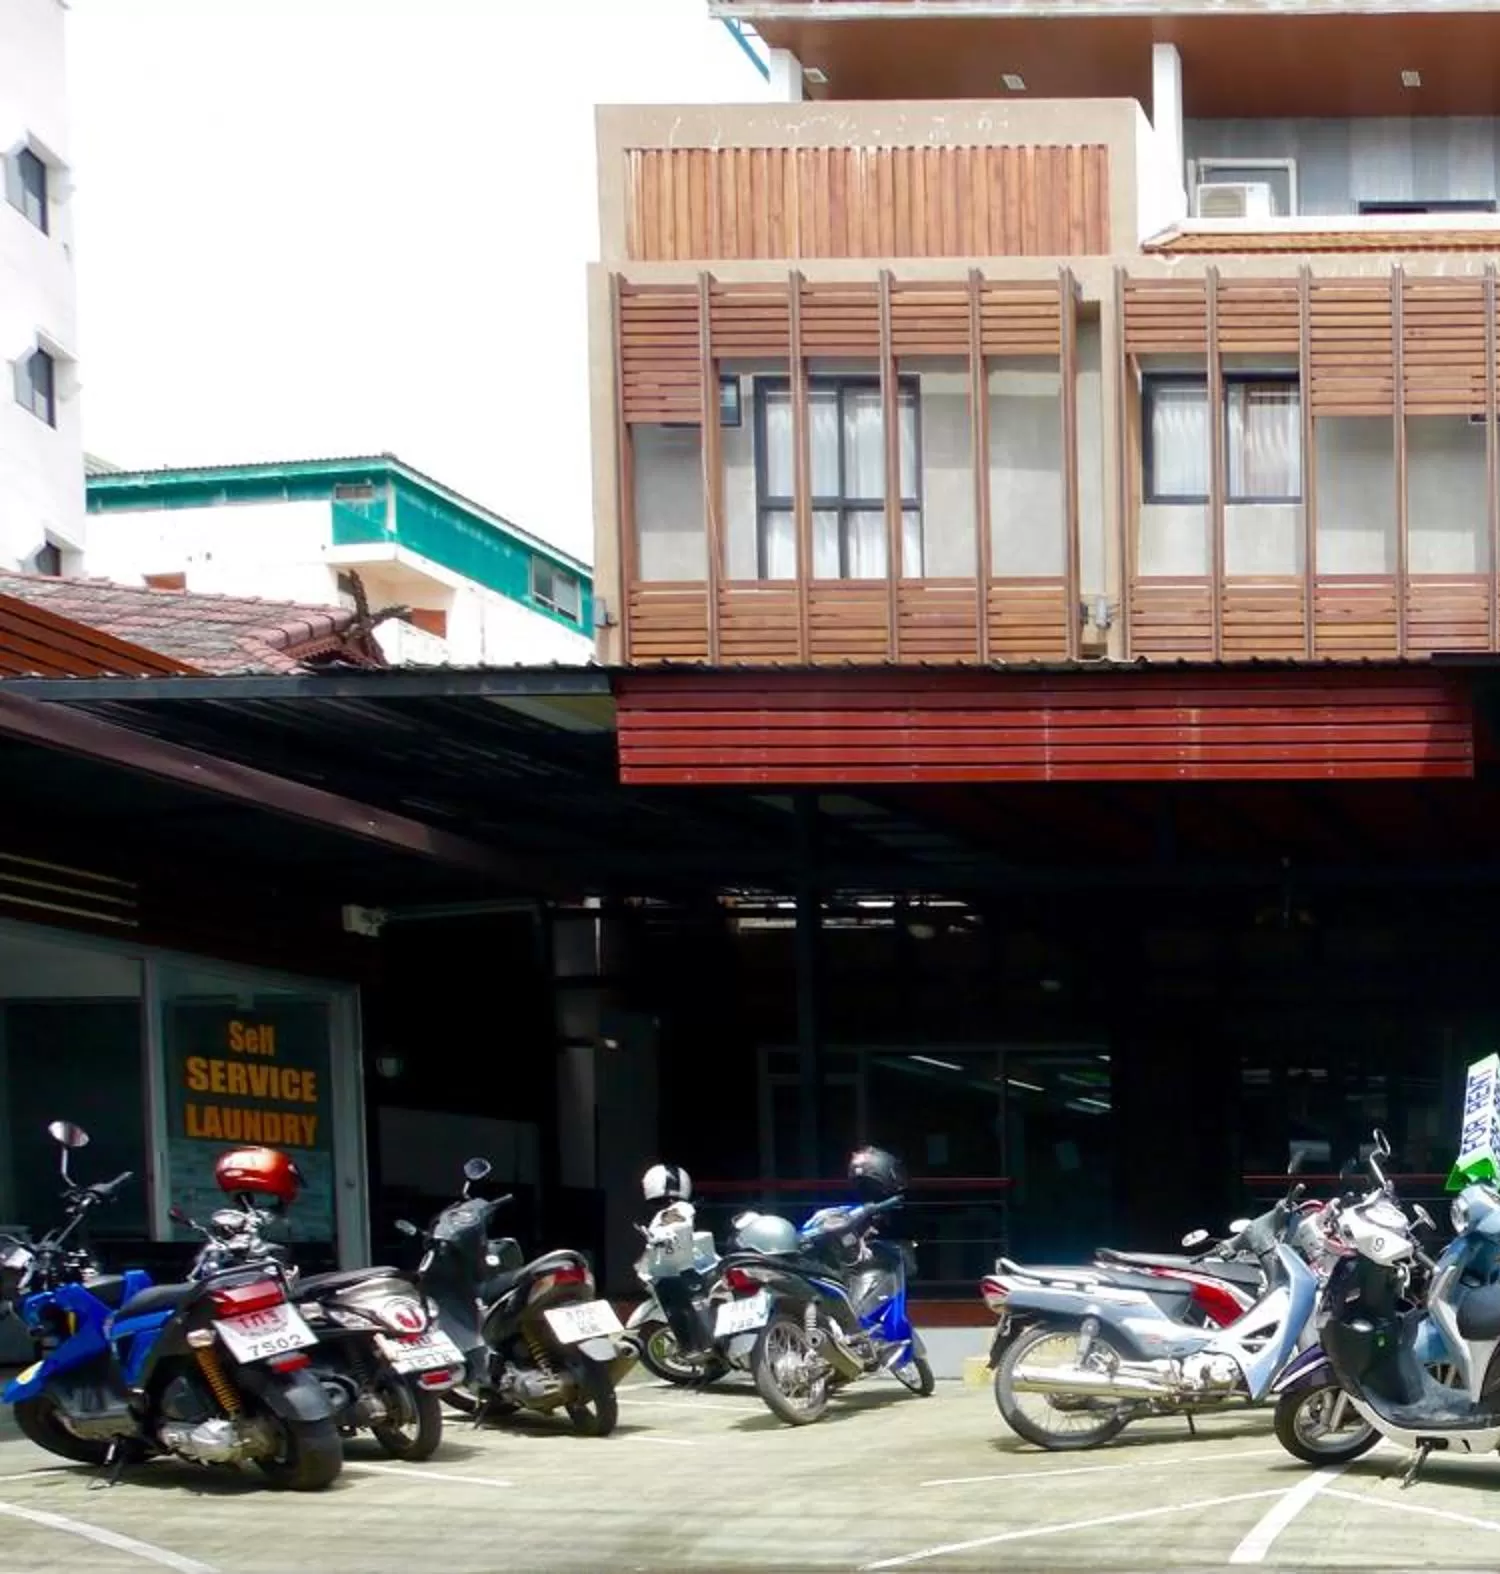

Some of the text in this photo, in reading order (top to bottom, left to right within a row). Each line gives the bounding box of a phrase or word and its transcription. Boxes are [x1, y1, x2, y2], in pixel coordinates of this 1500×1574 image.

[228, 1020, 275, 1056] Self
[185, 1056, 317, 1102] SERVICE
[185, 1103, 317, 1146] LAUNDRY
[1461, 1068, 1493, 1156] FOR RENT
[246, 1334, 305, 1357] 7502
